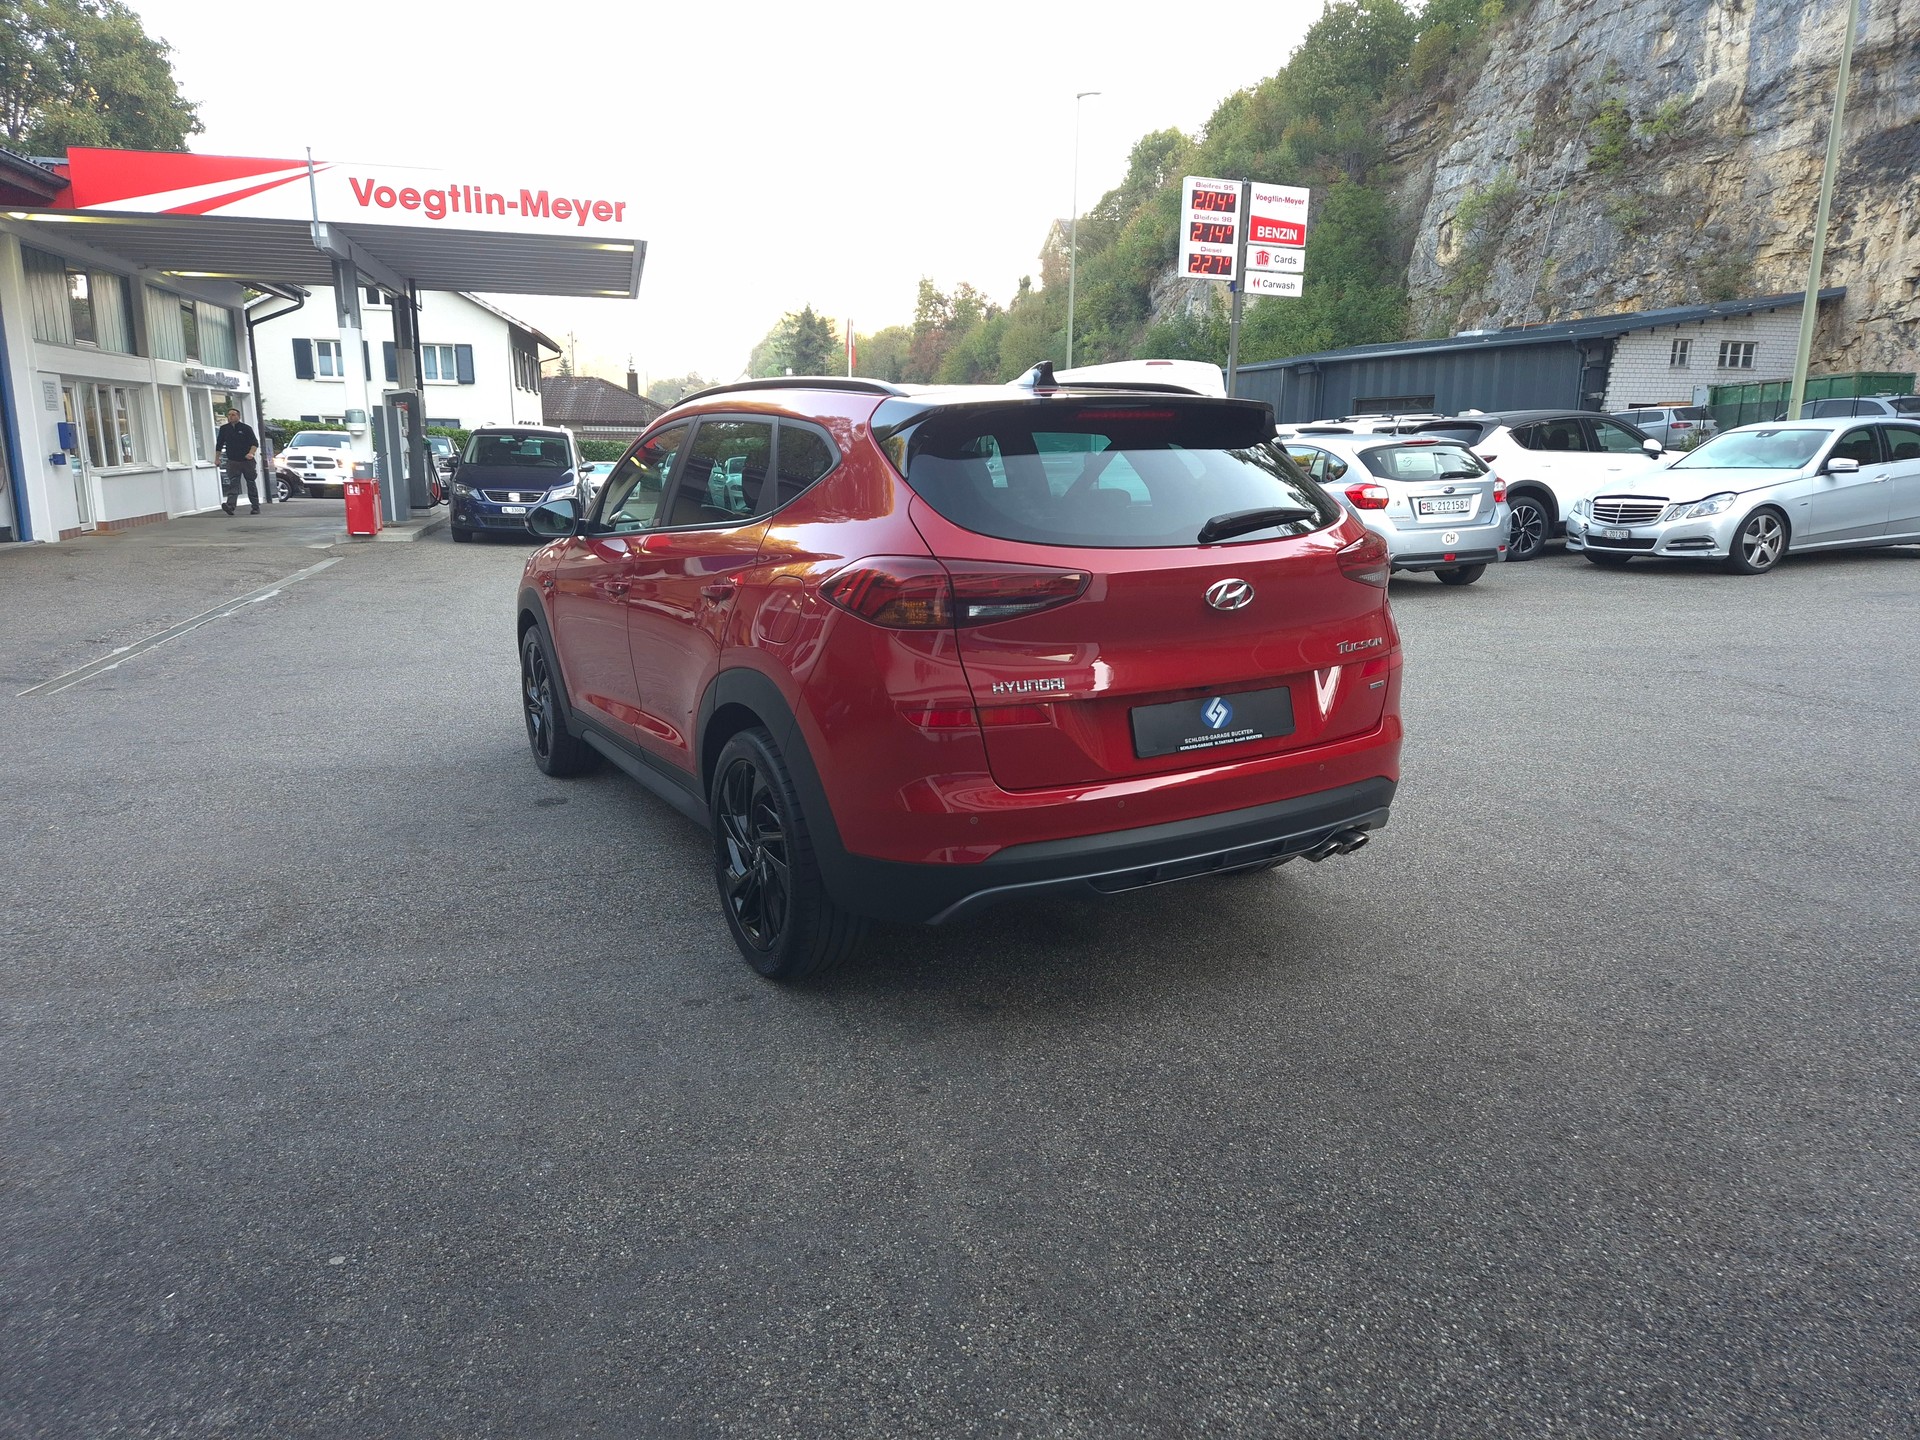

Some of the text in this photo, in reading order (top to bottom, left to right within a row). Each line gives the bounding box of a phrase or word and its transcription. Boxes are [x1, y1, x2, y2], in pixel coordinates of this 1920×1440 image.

[1195, 181, 1222, 190] Bleifrei
[348, 176, 627, 227] Voegtlin-Meyer
[1255, 193, 1305, 206] Voegtlin-Meyer
[1194, 213, 1220, 222] Bleifrei
[1257, 225, 1298, 241] BENZIN
[1200, 246, 1222, 254] Diesel
[1274, 254, 1297, 265] Cards
[1262, 279, 1296, 290] Carwash
[1445, 533, 1456, 544] CH
[992, 677, 1066, 695] HYUNDAI
[1184, 728, 1254, 744] SCHLOSS-GARAGE BUCKTEN
